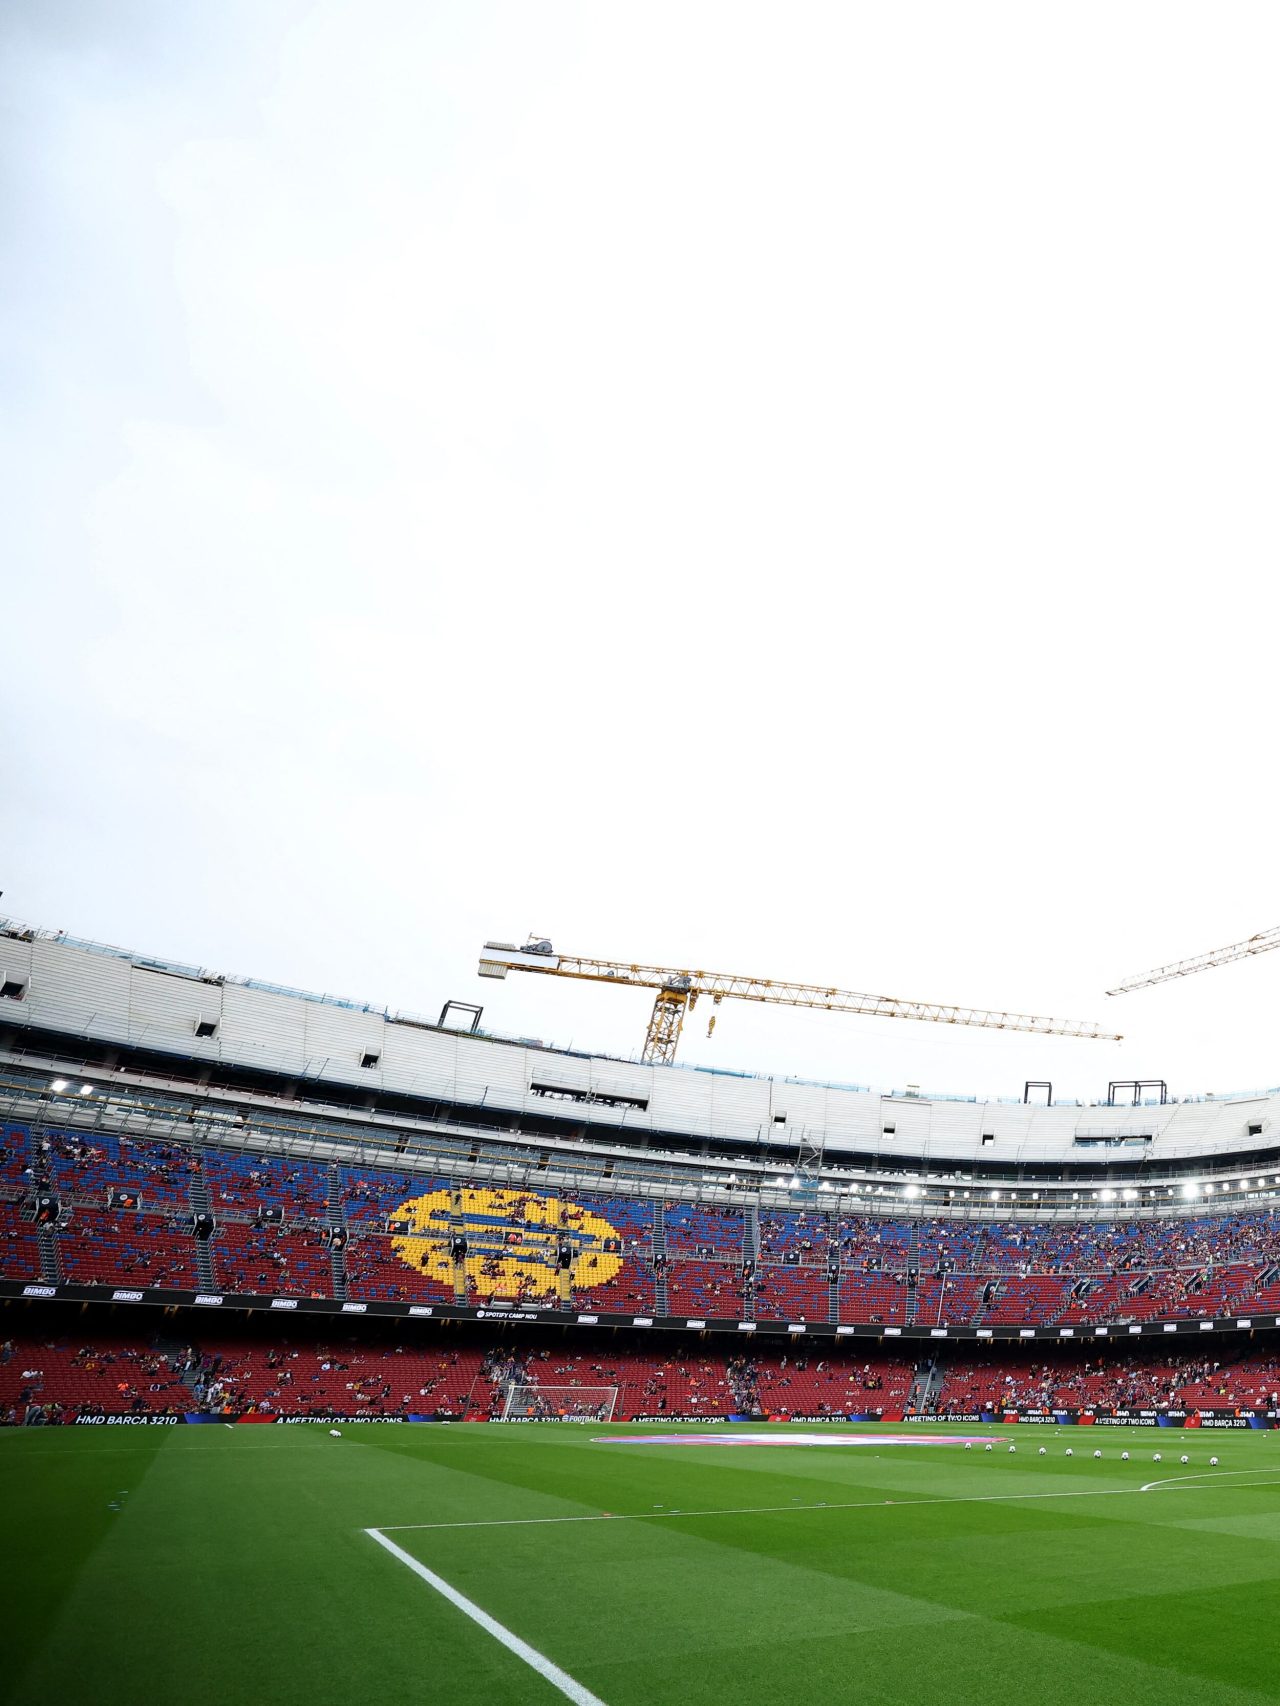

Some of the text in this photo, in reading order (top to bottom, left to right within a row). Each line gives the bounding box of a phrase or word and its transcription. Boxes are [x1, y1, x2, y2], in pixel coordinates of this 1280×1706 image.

[23, 1287, 56, 1295] BIMBO
[112, 1292, 143, 1300] BIMBO
[76, 1416, 104, 1424] HMD
[150, 1416, 177, 1424] 3210
[1202, 1418, 1246, 1428] HMD BARÇA 3210
